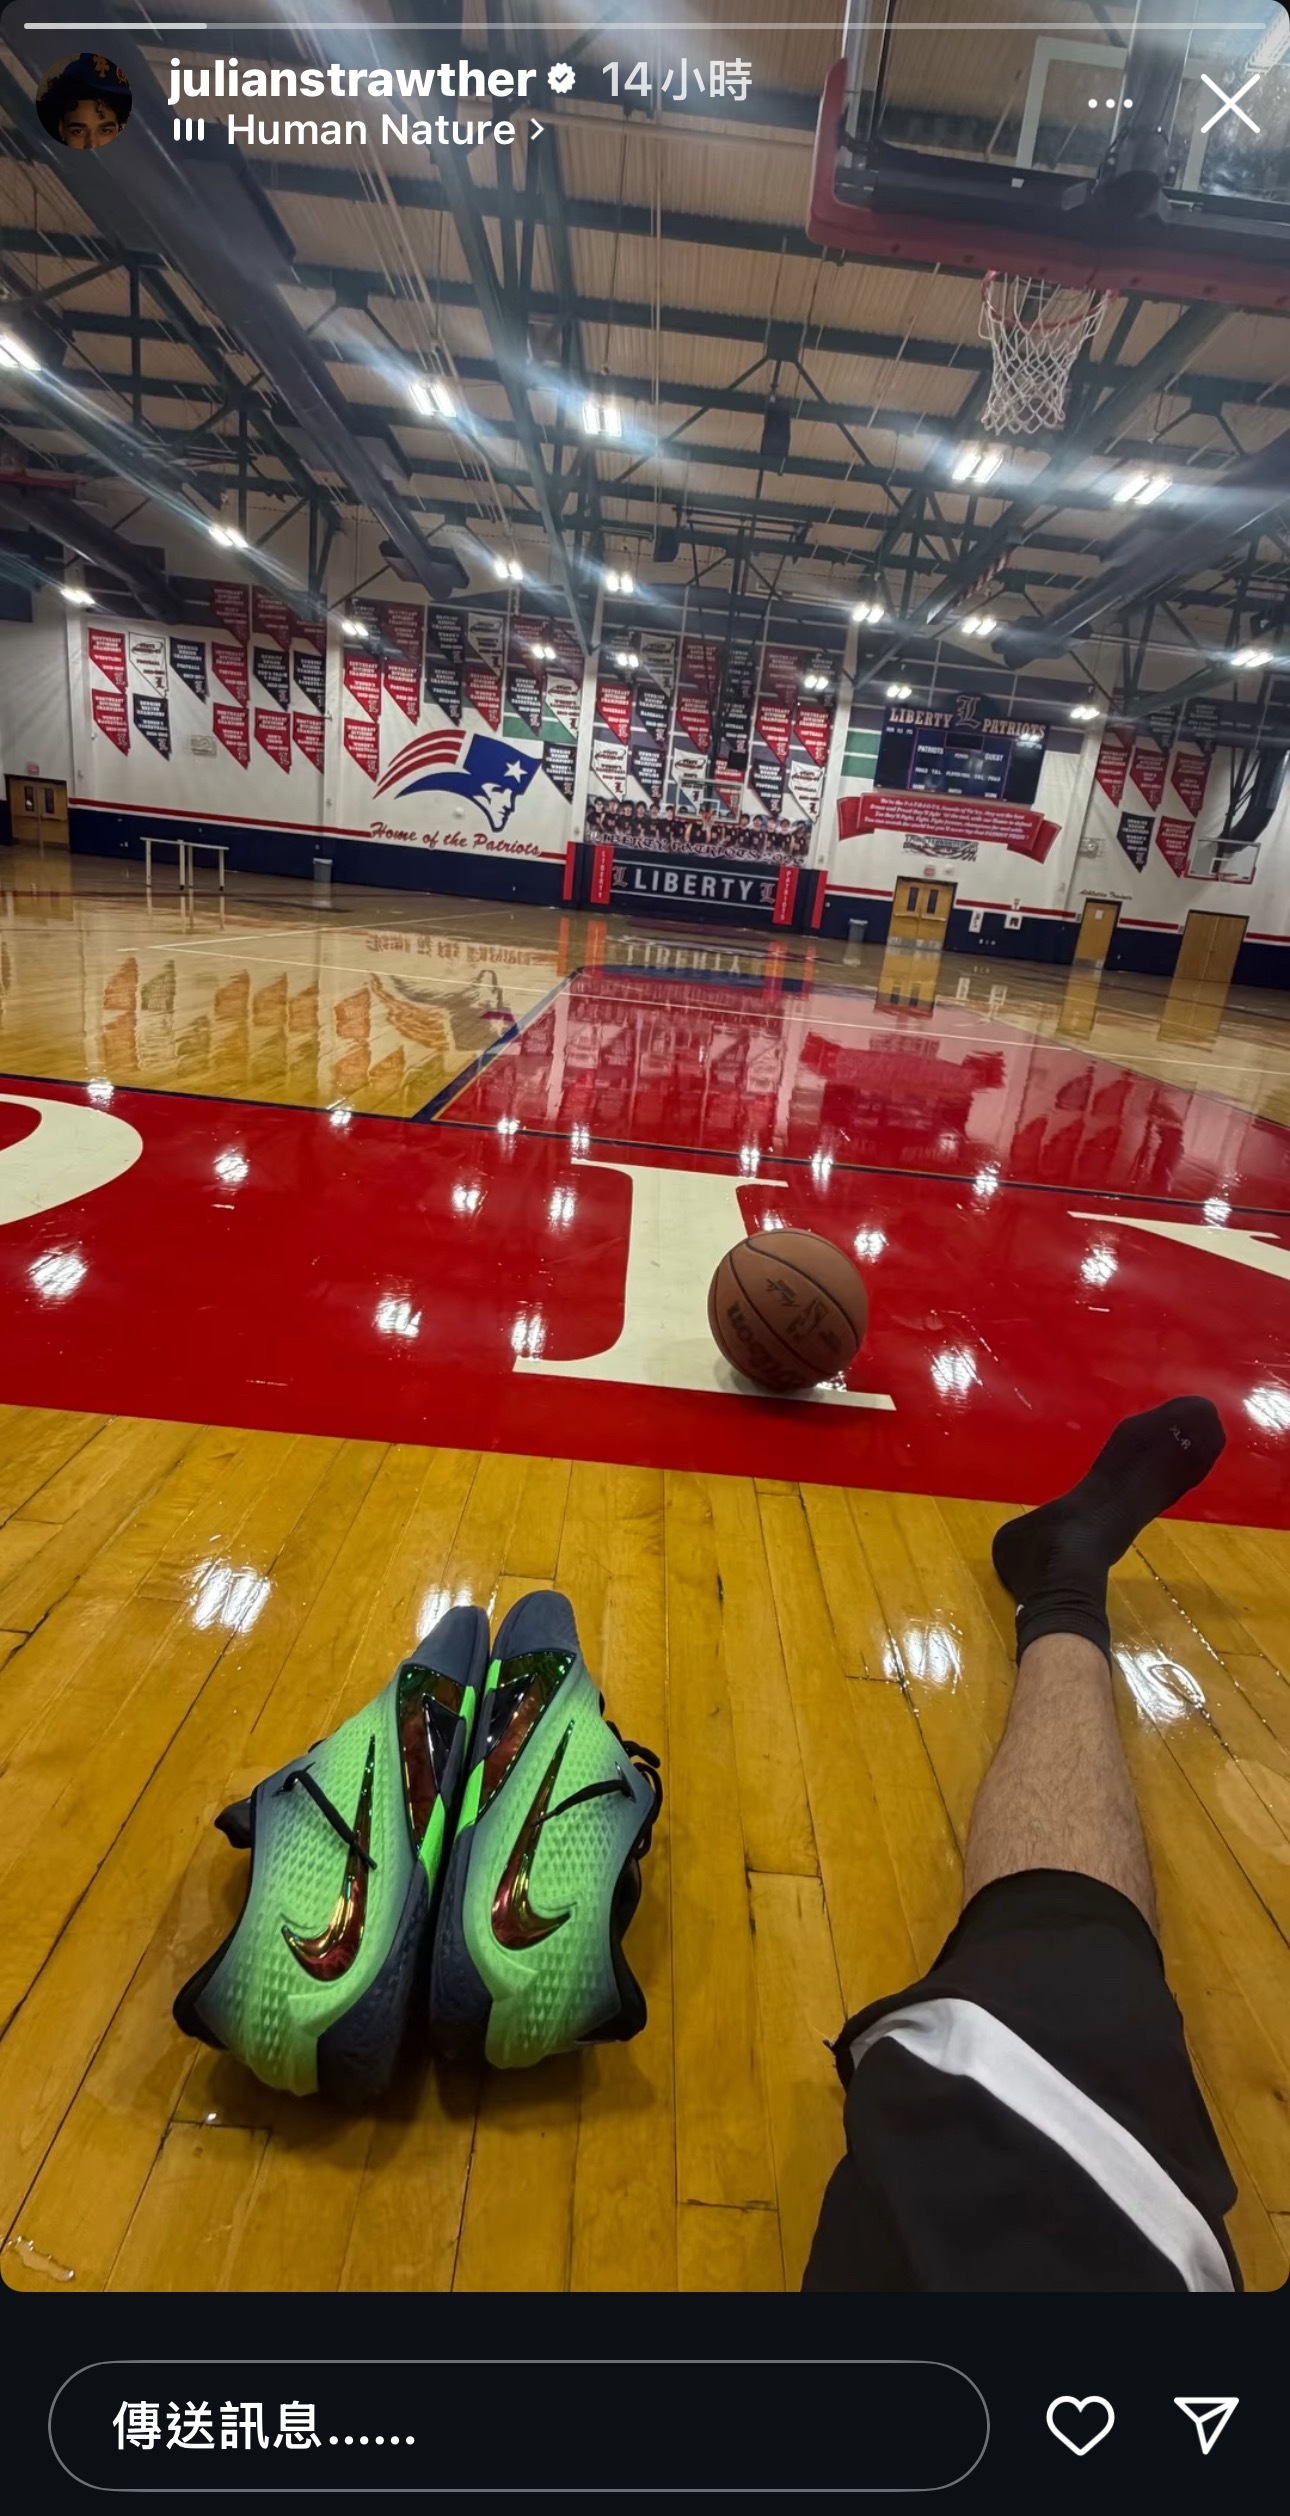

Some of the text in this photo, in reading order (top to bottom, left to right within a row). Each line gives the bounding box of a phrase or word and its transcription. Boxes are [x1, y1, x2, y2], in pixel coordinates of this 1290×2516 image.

[890, 708, 954, 728] LIBERTY
[983, 718, 1046, 739] PATRIOTS
[369, 821, 542, 858] Home of the Patriots
[634, 868, 754, 902] LIBERTY
